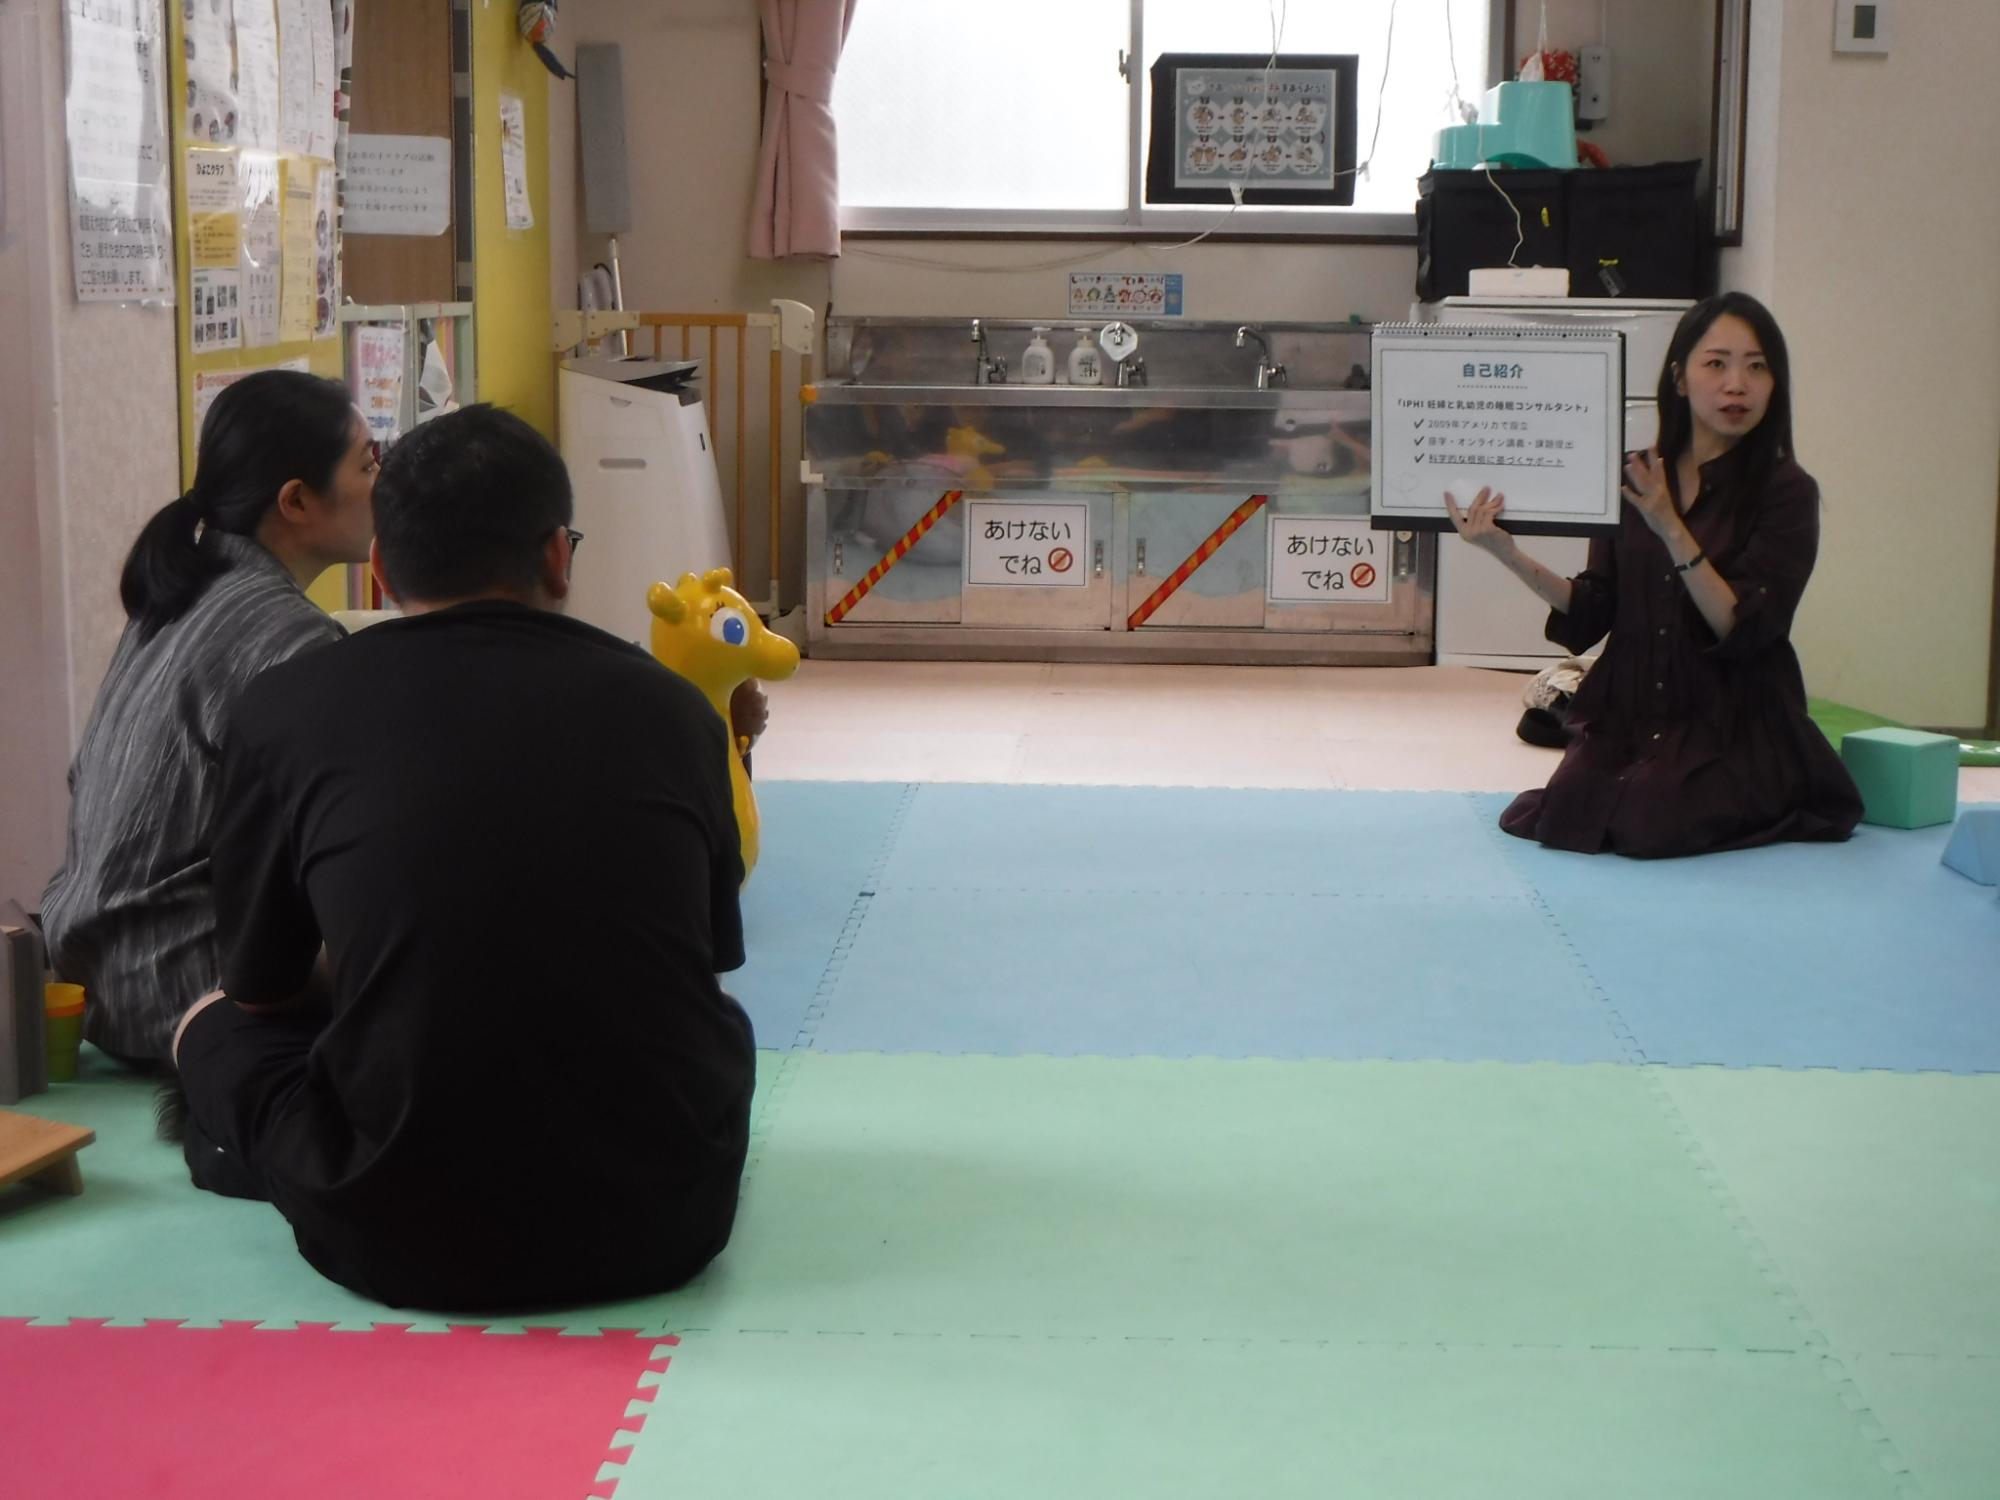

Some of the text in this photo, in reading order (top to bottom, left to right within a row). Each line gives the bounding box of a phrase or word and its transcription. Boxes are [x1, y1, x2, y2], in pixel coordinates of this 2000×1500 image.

[1462, 363, 1524, 379] 自己紹介
[1427, 399, 1589, 413] 妊婦と乳幼児の睡眠コンサルタント」
[1428, 420, 1528, 431] 2009年アメリカで設立
[1428, 454, 1563, 467] 科学的な根拠に基づくサポート
[983, 519, 1072, 541] あけない
[1286, 535, 1375, 557] あけない
[998, 553, 1042, 575] でね
[1301, 568, 1345, 590] でね
